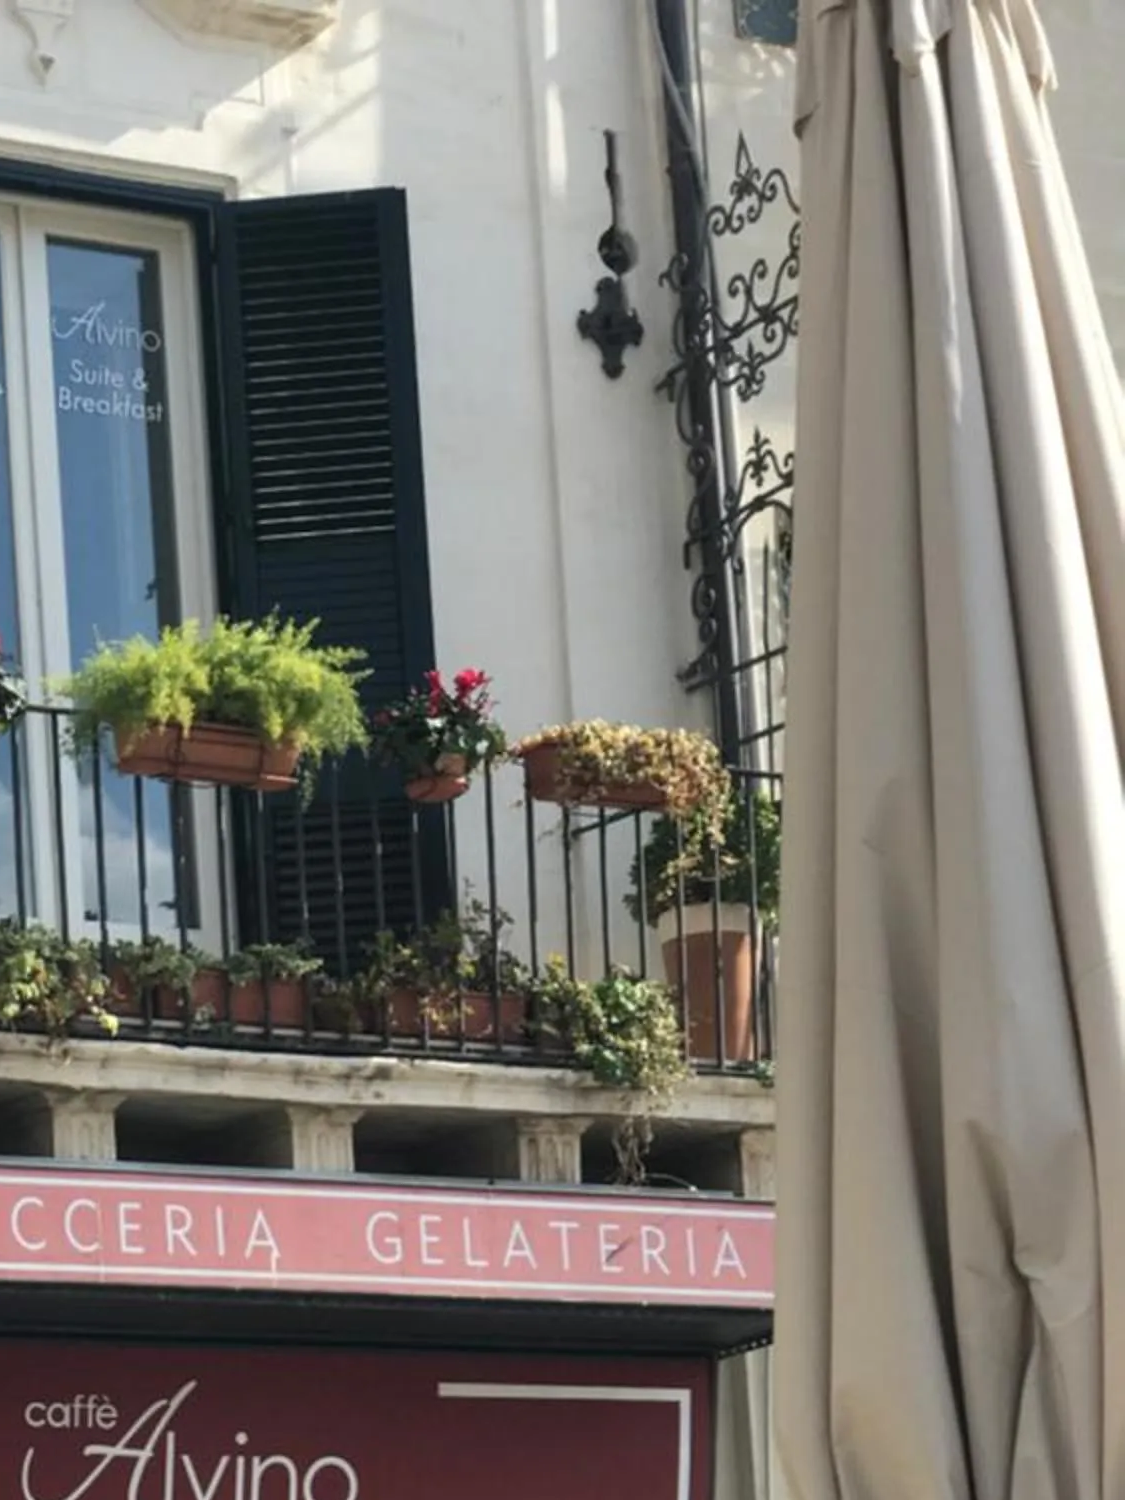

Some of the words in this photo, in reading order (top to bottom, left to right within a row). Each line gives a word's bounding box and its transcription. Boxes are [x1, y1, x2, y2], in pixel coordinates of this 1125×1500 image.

[53, 300, 161, 352] Alvino
[69, 359, 124, 388] Suite
[133, 367, 149, 392] &
[58, 386, 163, 422] Breakfast
[366, 1211, 746, 1279] GELATERIA
[25, 1395, 118, 1429] caffè
